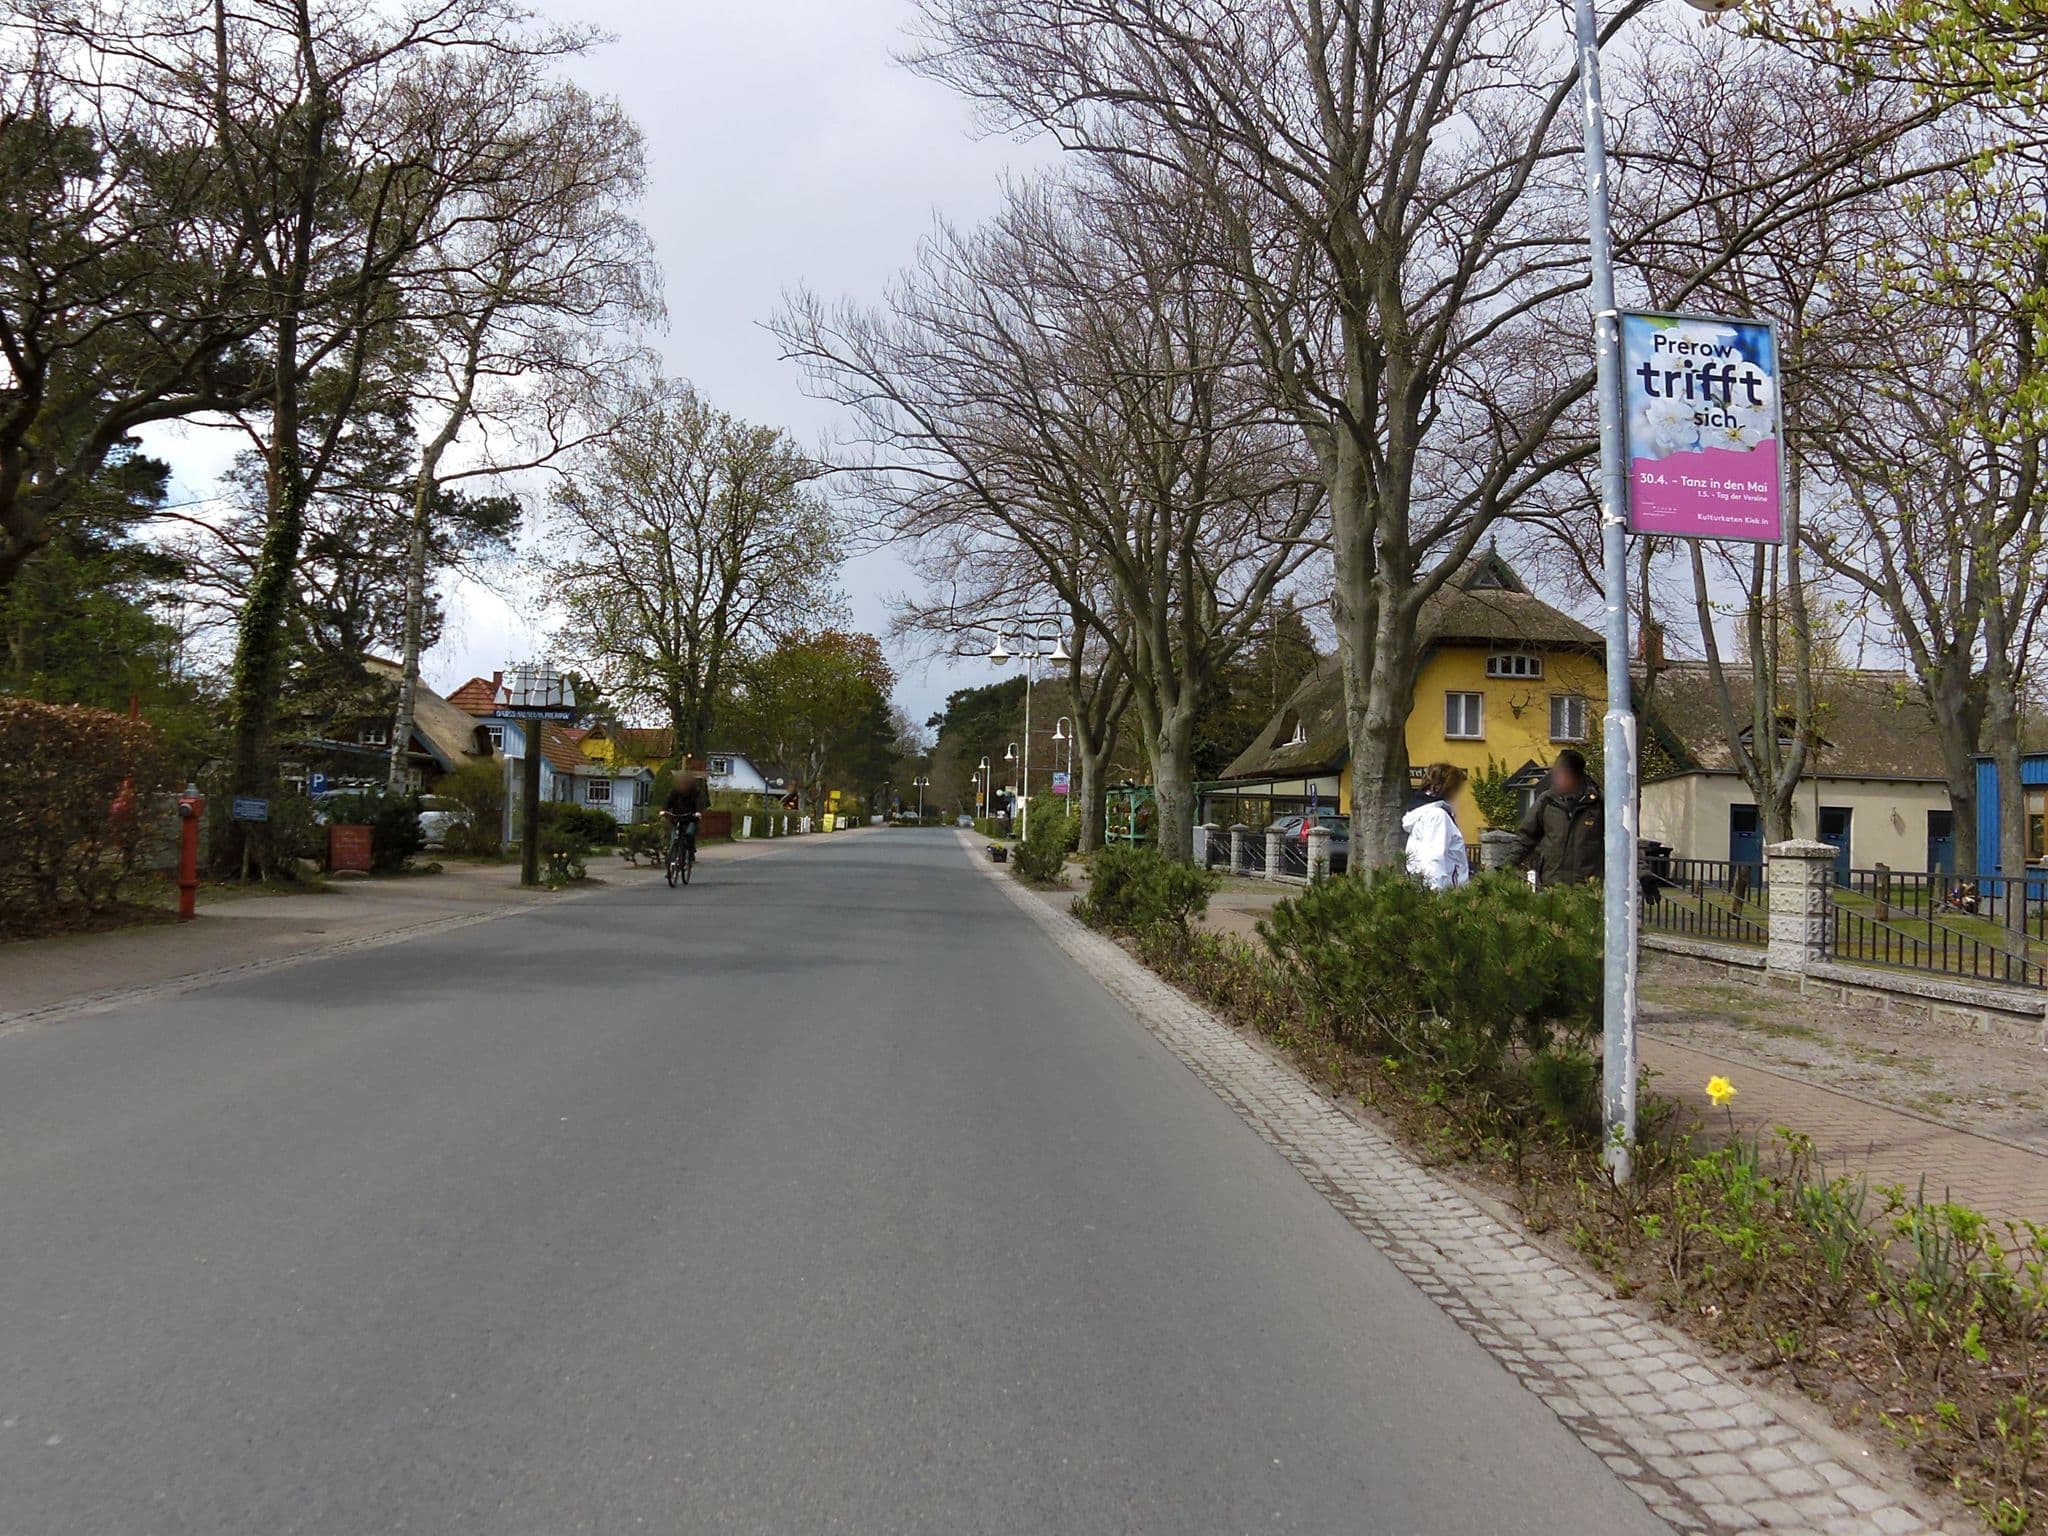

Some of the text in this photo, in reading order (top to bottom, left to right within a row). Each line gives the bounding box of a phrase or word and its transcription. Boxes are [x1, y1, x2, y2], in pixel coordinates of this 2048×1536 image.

[1654, 334, 1732, 358] Prerow
[1637, 359, 1762, 406] trifft
[1693, 408, 1737, 428] sich
[1640, 472, 1668, 485] 30.4.
[1680, 475, 1707, 488] Tanz
[1710, 478, 1721, 489] in
[1724, 480, 1744, 491] den
[1747, 482, 1768, 493] Mai
[1697, 490, 1710, 498] 1.5.
[1716, 492, 1729, 501] Tag
[311, 773, 325, 787] P
